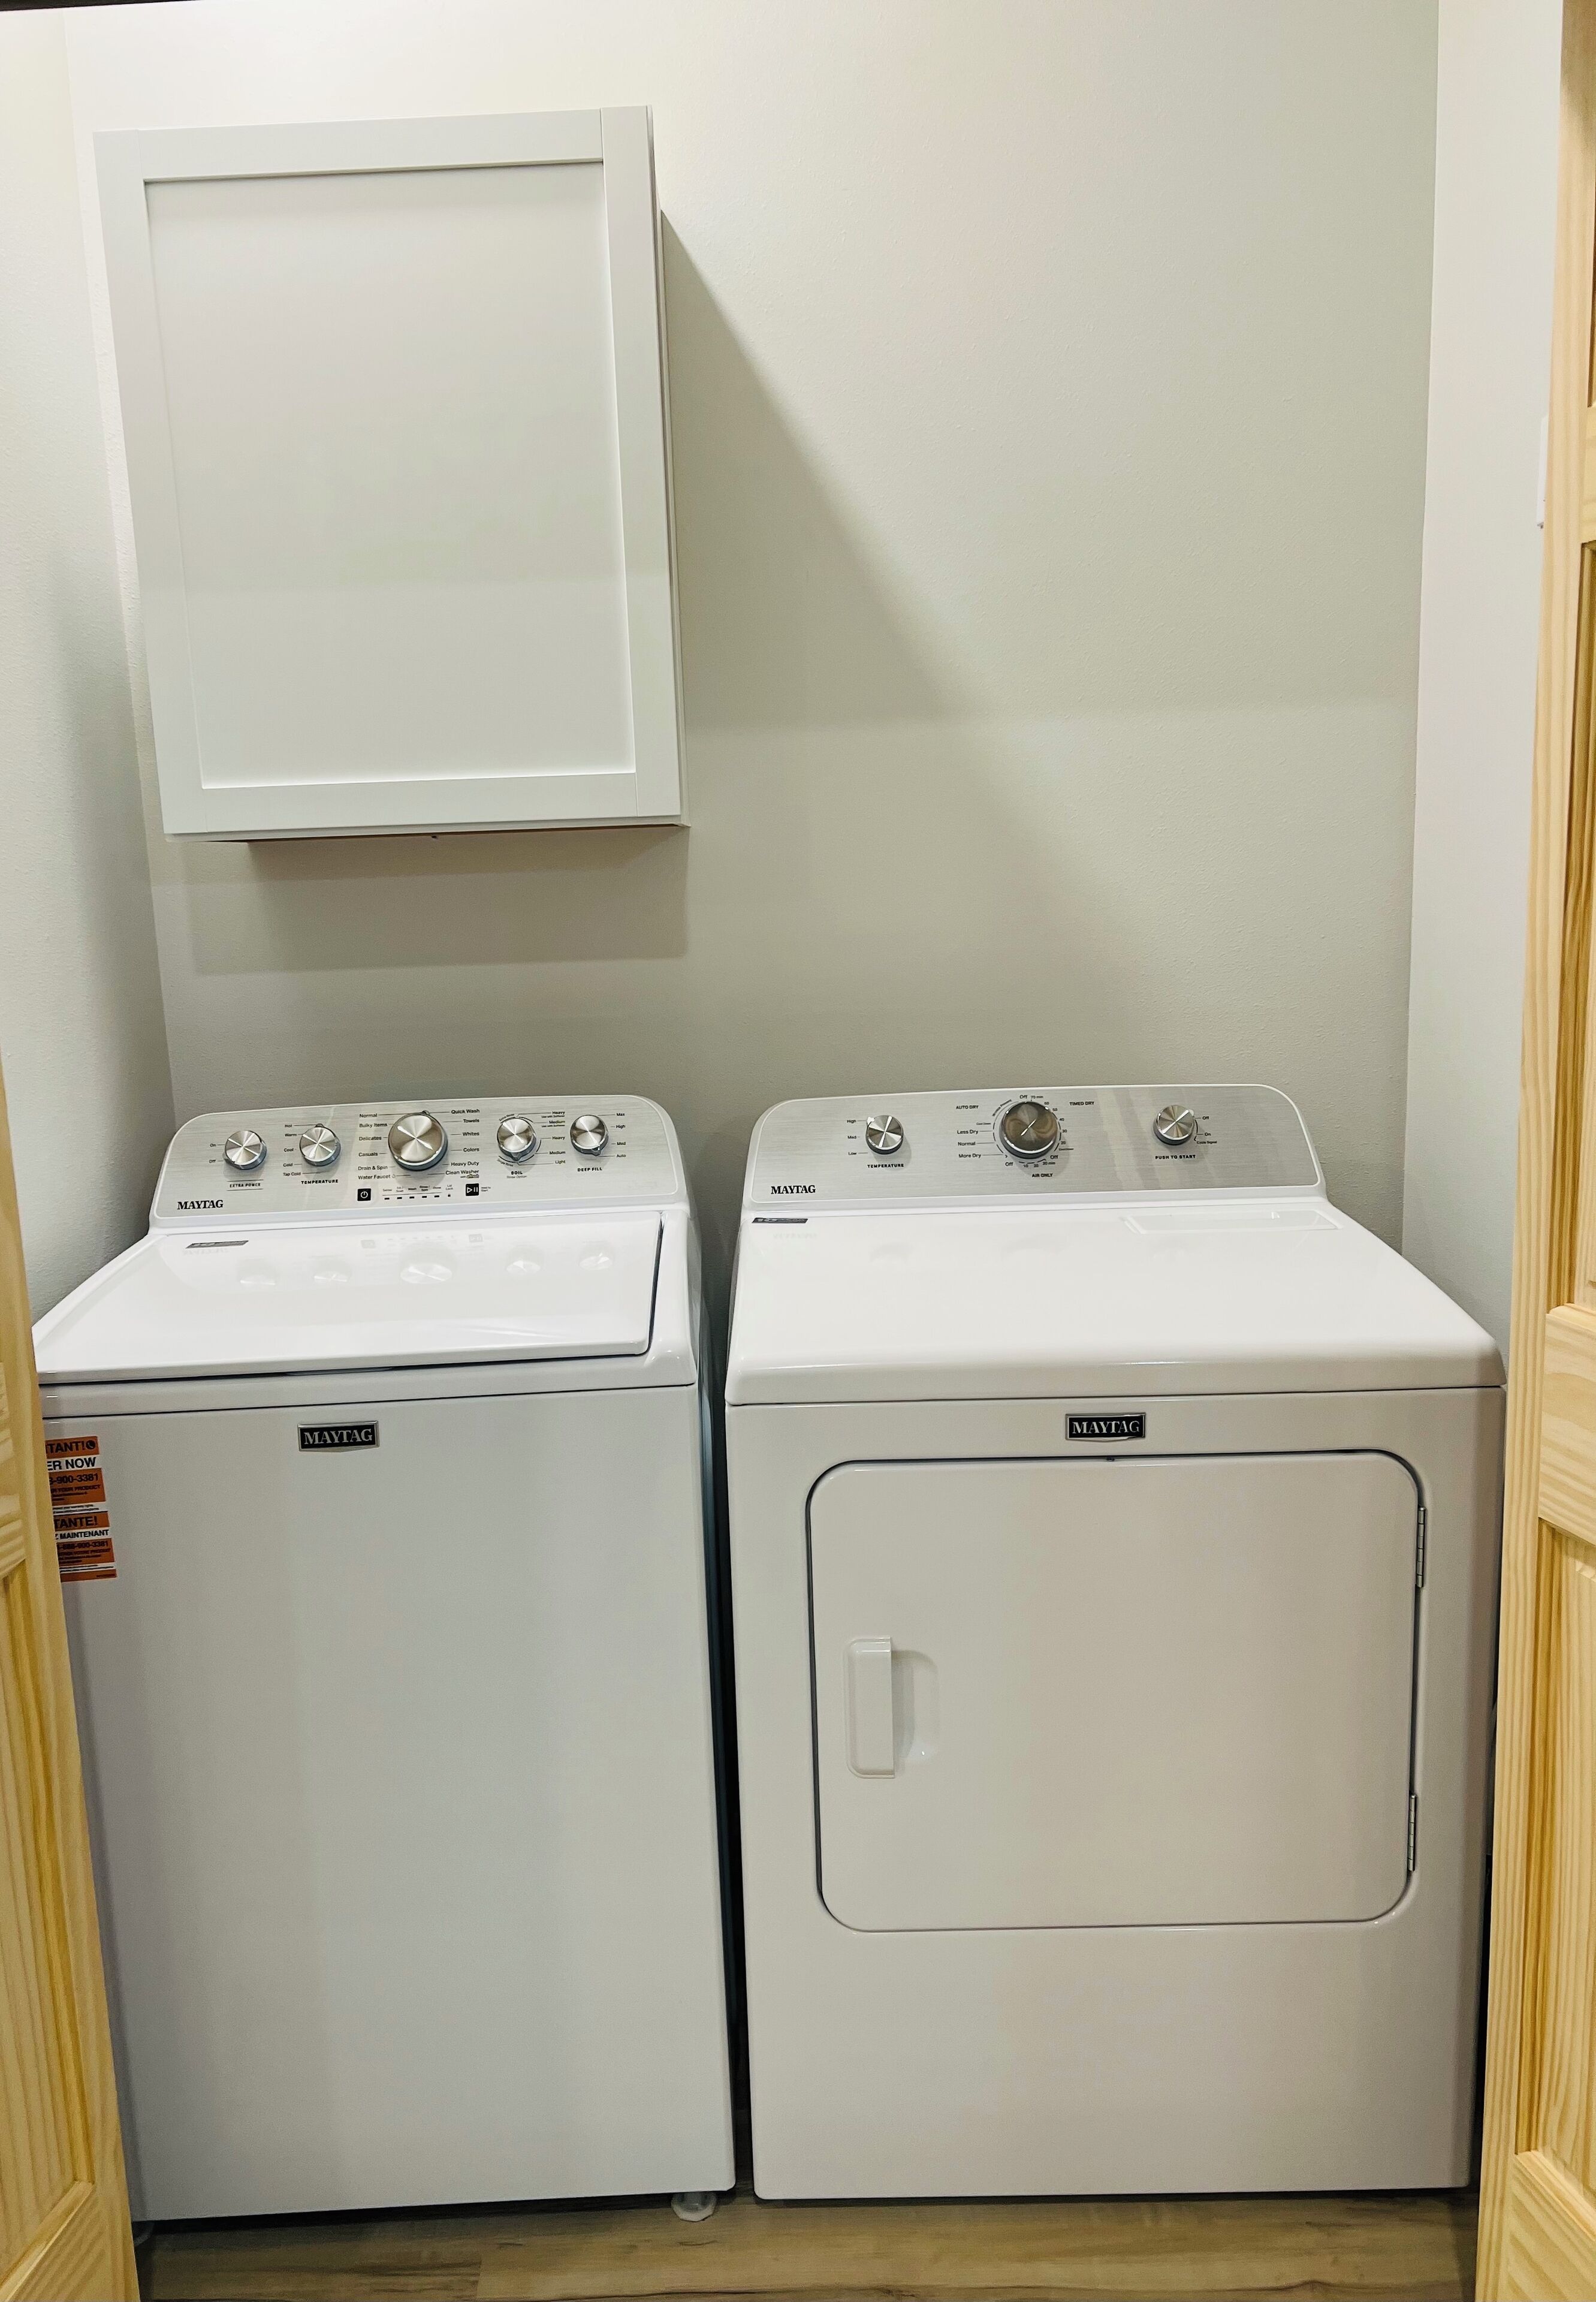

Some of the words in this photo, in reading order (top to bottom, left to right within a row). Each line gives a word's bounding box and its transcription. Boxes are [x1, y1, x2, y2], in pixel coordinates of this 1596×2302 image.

[771, 1185, 816, 1194] MAYTAG
[177, 1199, 224, 1210] MAYTAG
[1072, 1420, 1140, 1433] MAYTAG
[303, 1429, 373, 1444] MAYTAG
[46, 1441, 85, 1454] TANT!
[65, 1457, 96, 1469] NOW
[53, 1515, 98, 1528] TANTE!
[60, 1529, 109, 1539] MAINTENANT
